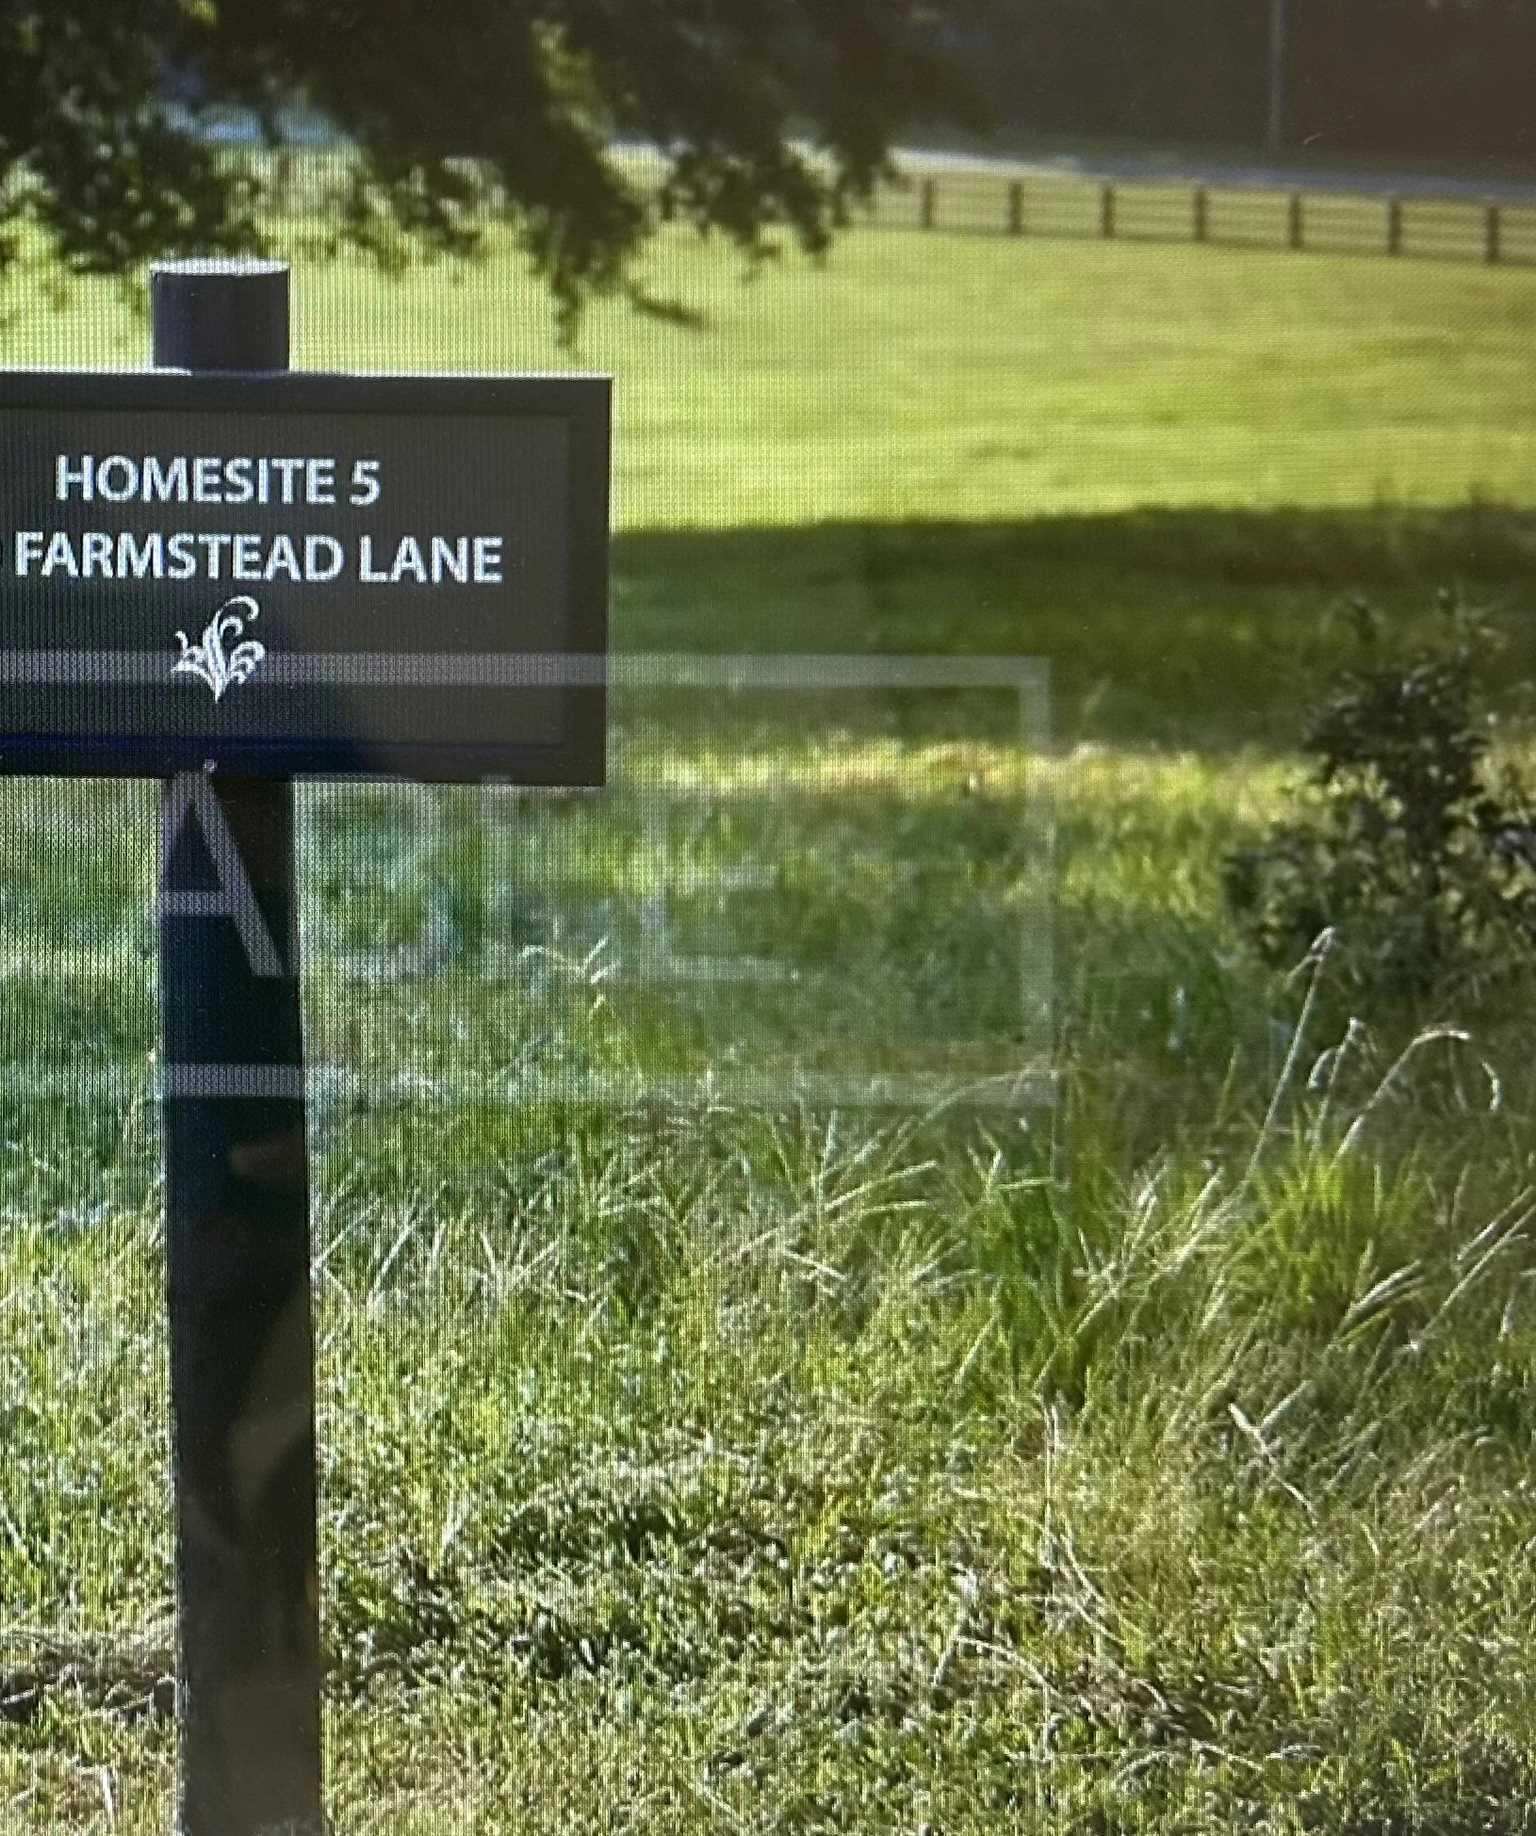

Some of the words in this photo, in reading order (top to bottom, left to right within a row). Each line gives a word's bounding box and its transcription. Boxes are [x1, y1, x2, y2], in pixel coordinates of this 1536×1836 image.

[55, 454, 336, 504] HOMESITE
[349, 460, 381, 506] 5
[14, 531, 345, 582] FARMSTEAD
[358, 534, 504, 584] LANE
